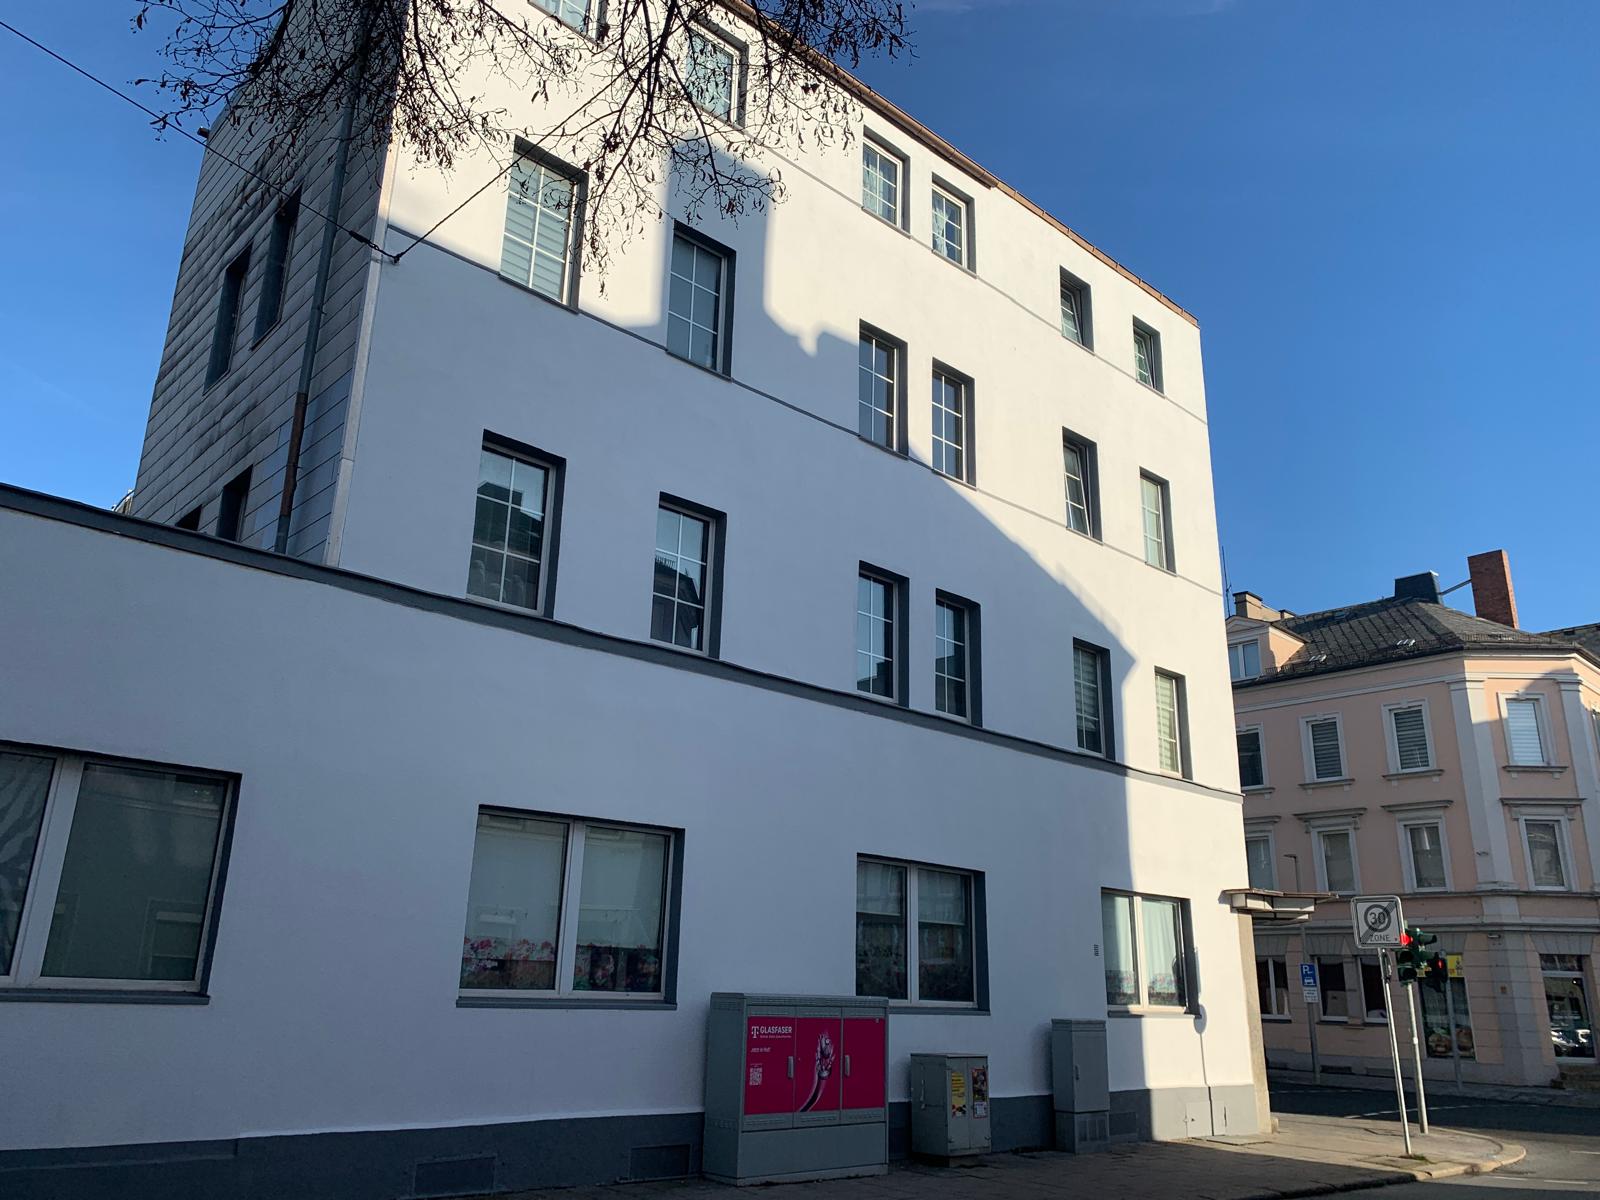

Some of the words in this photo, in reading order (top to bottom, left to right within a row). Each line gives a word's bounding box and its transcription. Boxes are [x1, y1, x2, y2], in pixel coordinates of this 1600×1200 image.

[1369, 911, 1386, 925] 30
[1370, 934, 1391, 942] ZONE
[1303, 965, 1310, 974] P
[760, 1025, 793, 1034] GLASFASER
